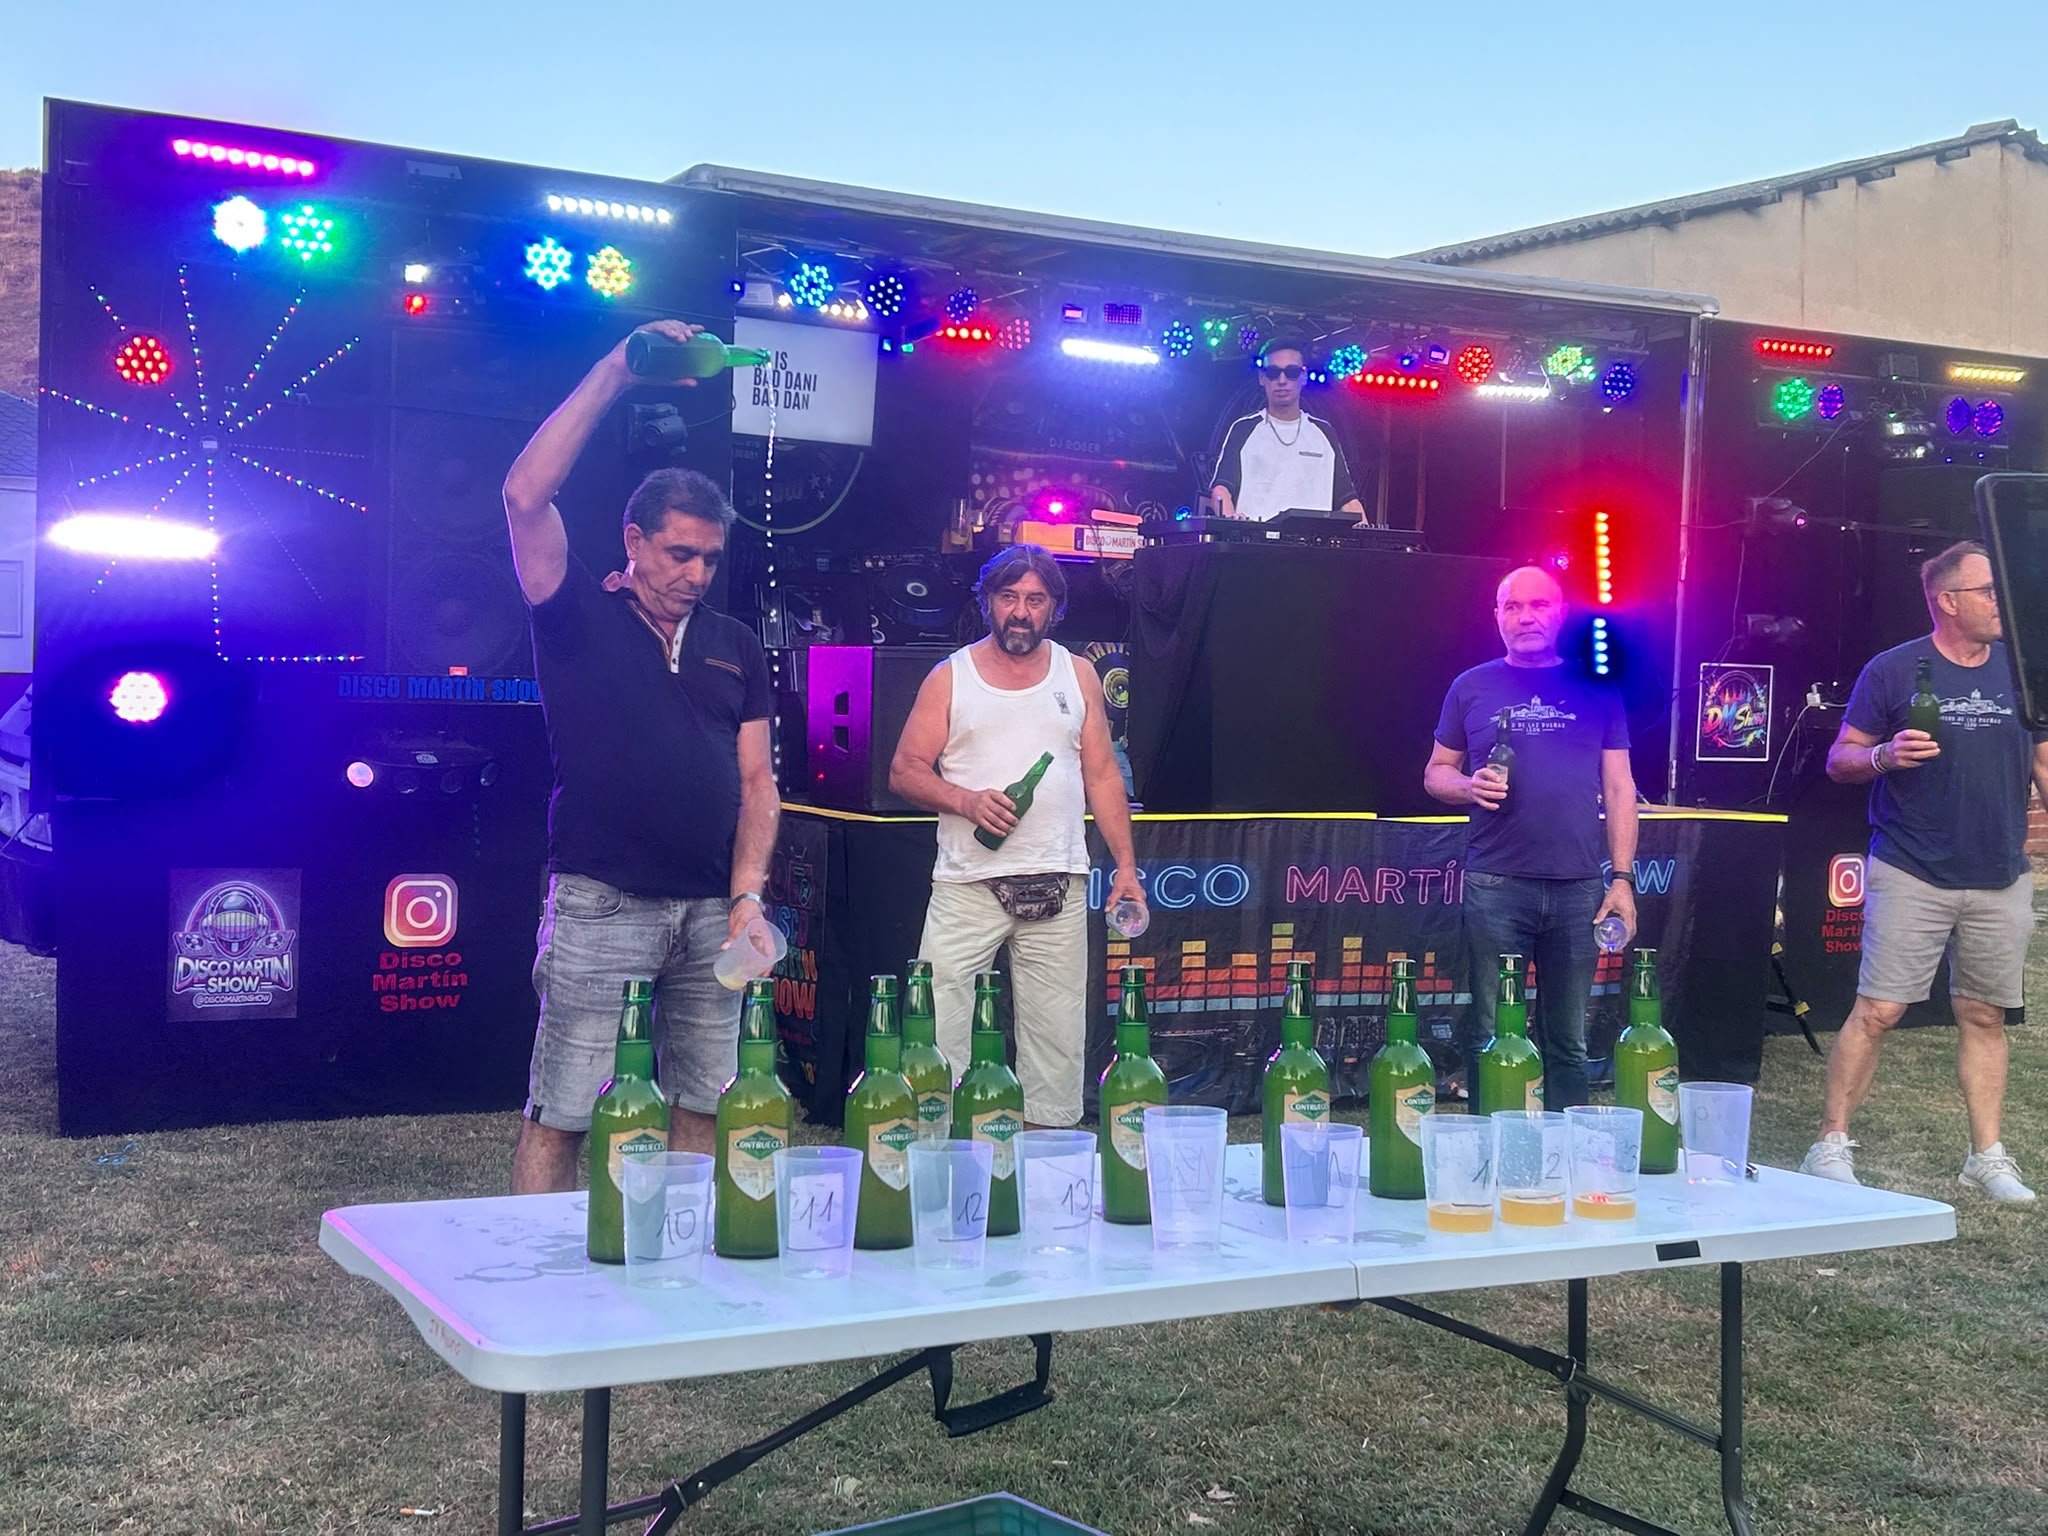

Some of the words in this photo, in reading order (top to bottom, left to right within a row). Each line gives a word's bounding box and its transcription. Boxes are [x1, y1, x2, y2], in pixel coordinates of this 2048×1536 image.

[775, 350, 788, 371] IS
[784, 370, 817, 393] DANI
[783, 390, 810, 411] DAN
[338, 675, 400, 697] DISCO
[1286, 860, 1465, 905] MARTÍ
[176, 957, 231, 990] DISCO
[380, 952, 462, 970] Disco
[207, 976, 260, 993] SHOW
[373, 970, 469, 991] Martín
[380, 994, 461, 1012] Show
[1545, 1152, 1563, 1180] 2
[1624, 1144, 1639, 1173] 3
[1471, 1159, 1490, 1191] 1
[799, 1191, 834, 1231] 11
[957, 1192, 986, 1225] 12
[1061, 1178, 1090, 1216] 13
[656, 1207, 697, 1246] 10
